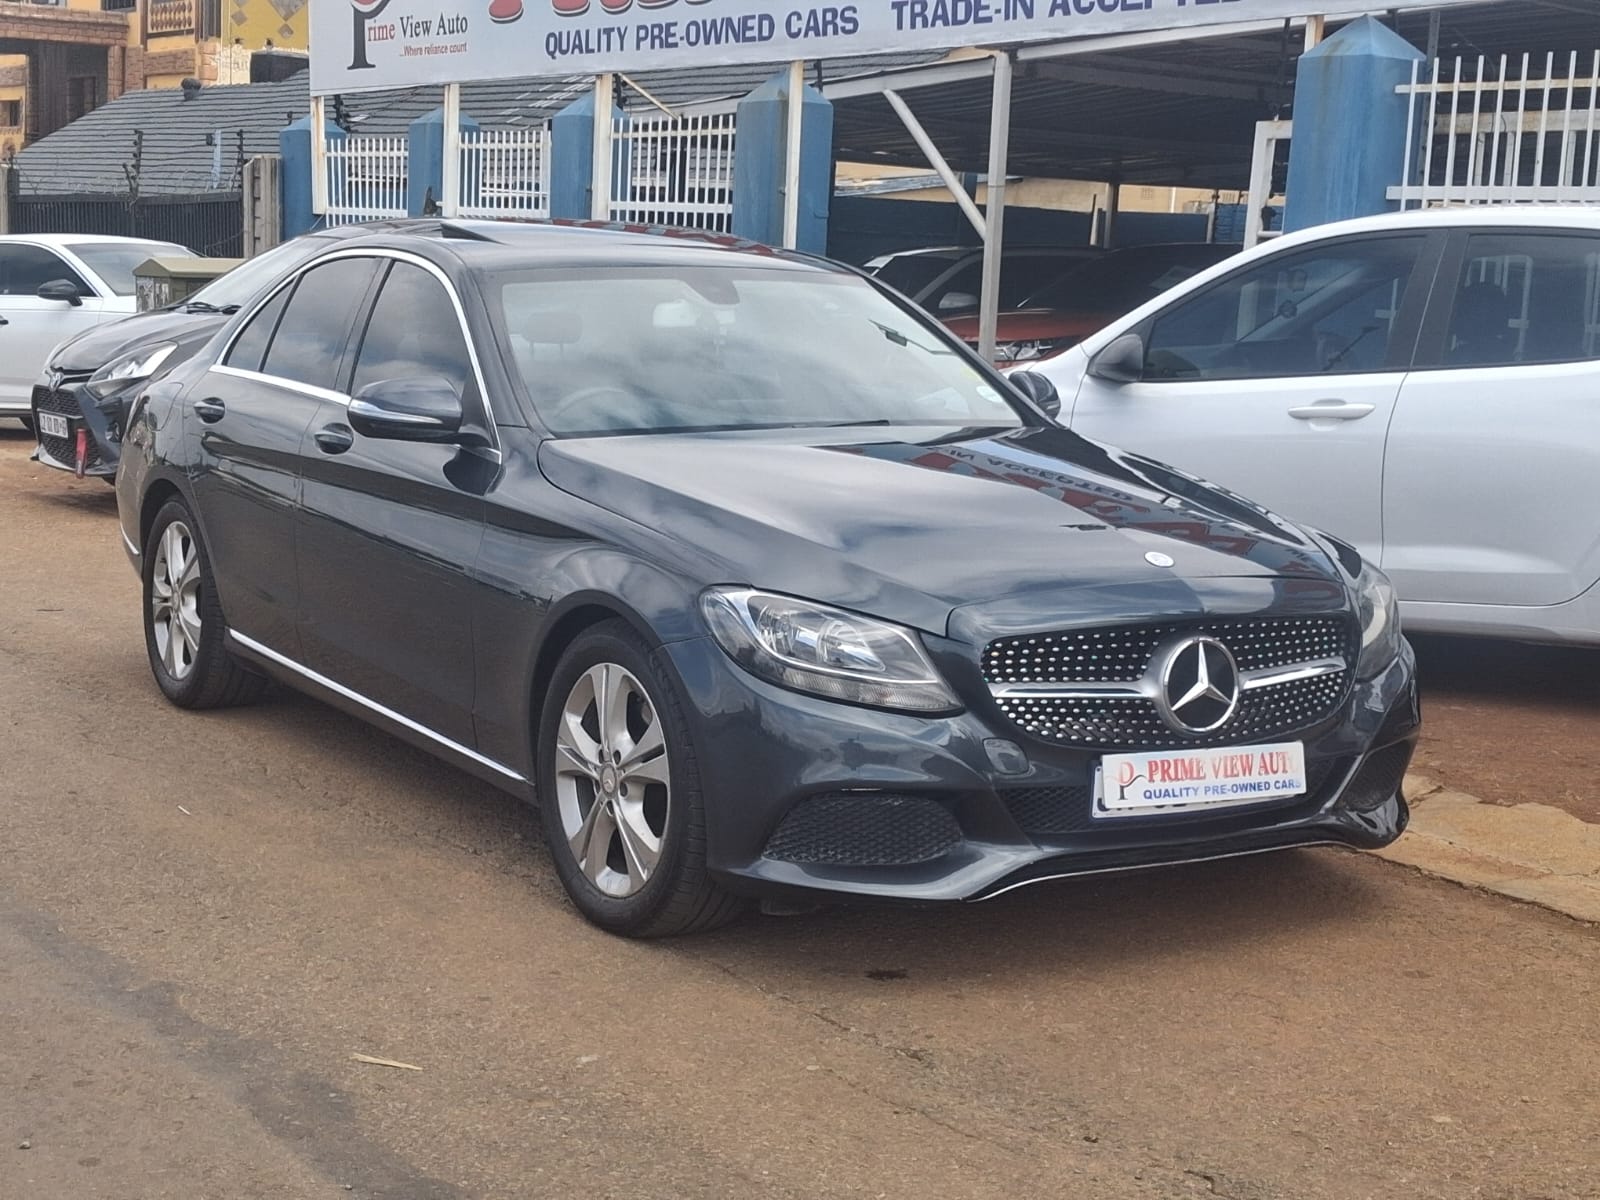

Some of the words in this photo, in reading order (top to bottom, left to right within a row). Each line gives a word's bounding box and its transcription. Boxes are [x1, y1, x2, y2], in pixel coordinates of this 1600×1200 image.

[399, 15, 432, 39] View
[436, 12, 468, 36] Auto
[545, 25, 628, 60] QUALITY
[635, 14, 775, 51] PRE-OWNED
[785, 5, 859, 39] CARS
[891, 0, 1035, 31] TRADE-IN
[424, 43, 449, 55] reliance
[449, 42, 468, 53] count
[1147, 758, 1207, 783] PRIME
[1212, 753, 1254, 780] VIEW
[1143, 786, 1200, 800] QUALITY
[1204, 780, 1271, 797] PRE-OWNED
